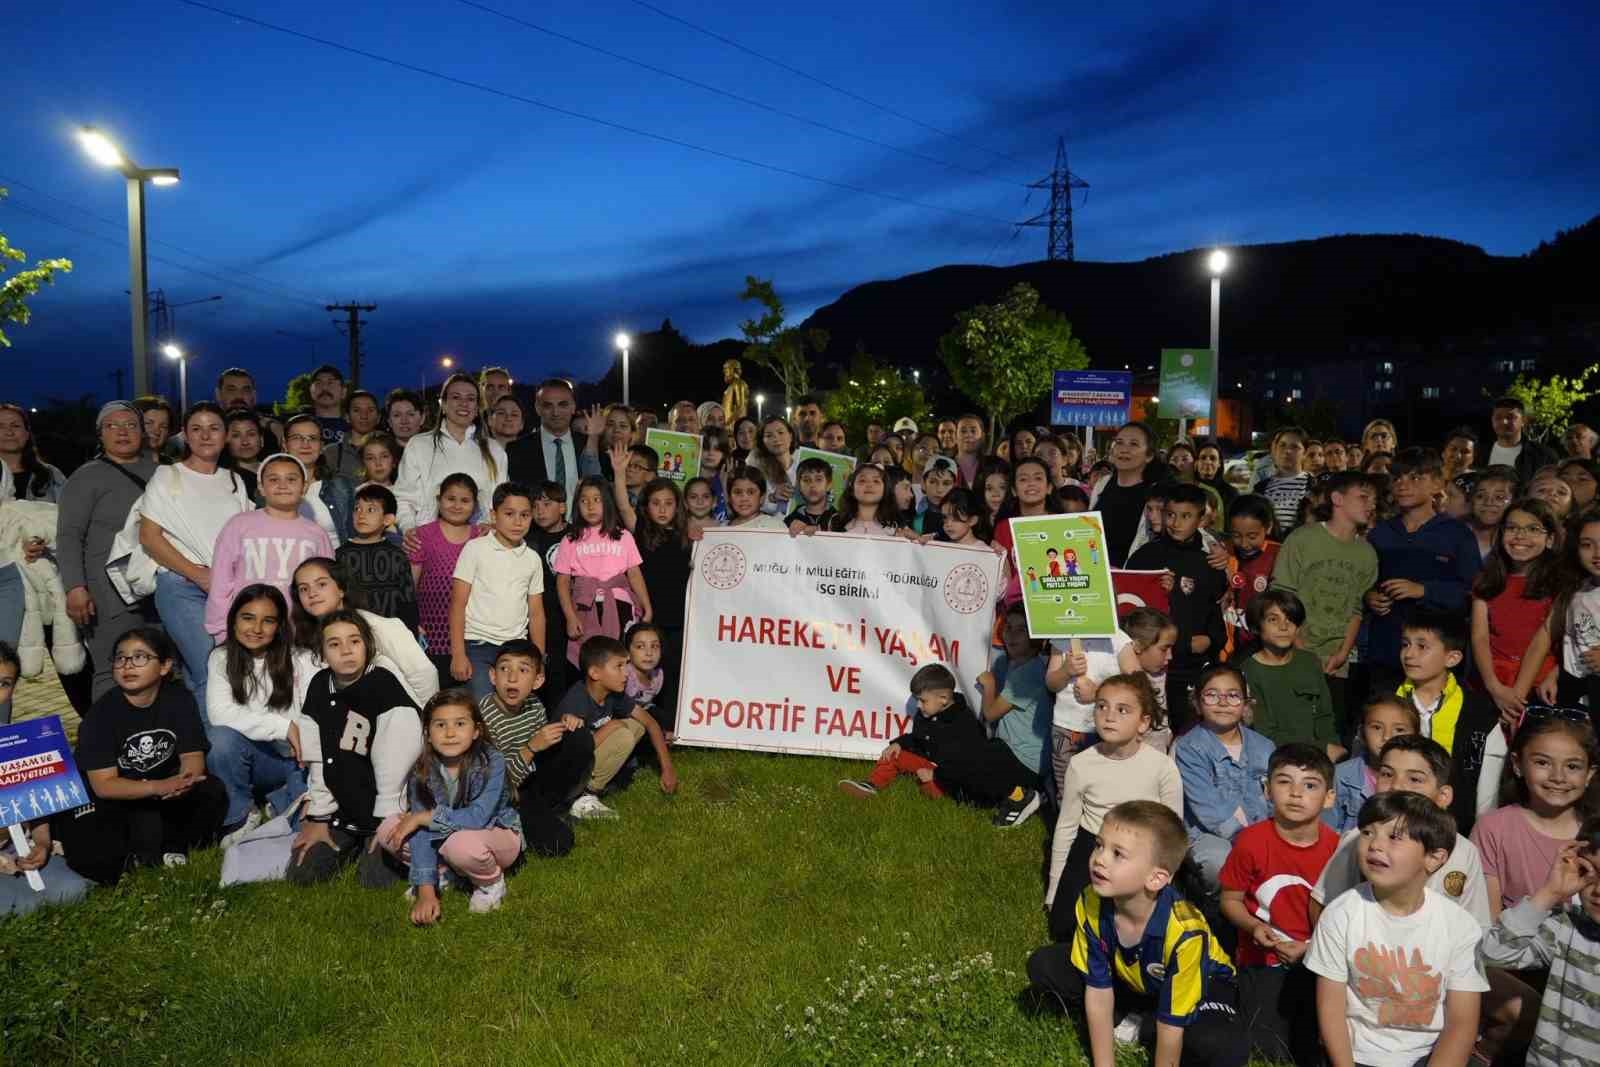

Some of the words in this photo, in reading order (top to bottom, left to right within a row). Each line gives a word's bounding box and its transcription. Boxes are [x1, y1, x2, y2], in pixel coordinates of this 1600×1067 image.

[806, 565, 833, 578] MİLLİ
[882, 571, 938, 588] ÜDÜRLÜĞÜ
[826, 664, 862, 694] VE
[340, 710, 370, 756] R
[688, 697, 806, 733] SPORTİF
[814, 705, 912, 740] FAALİY
